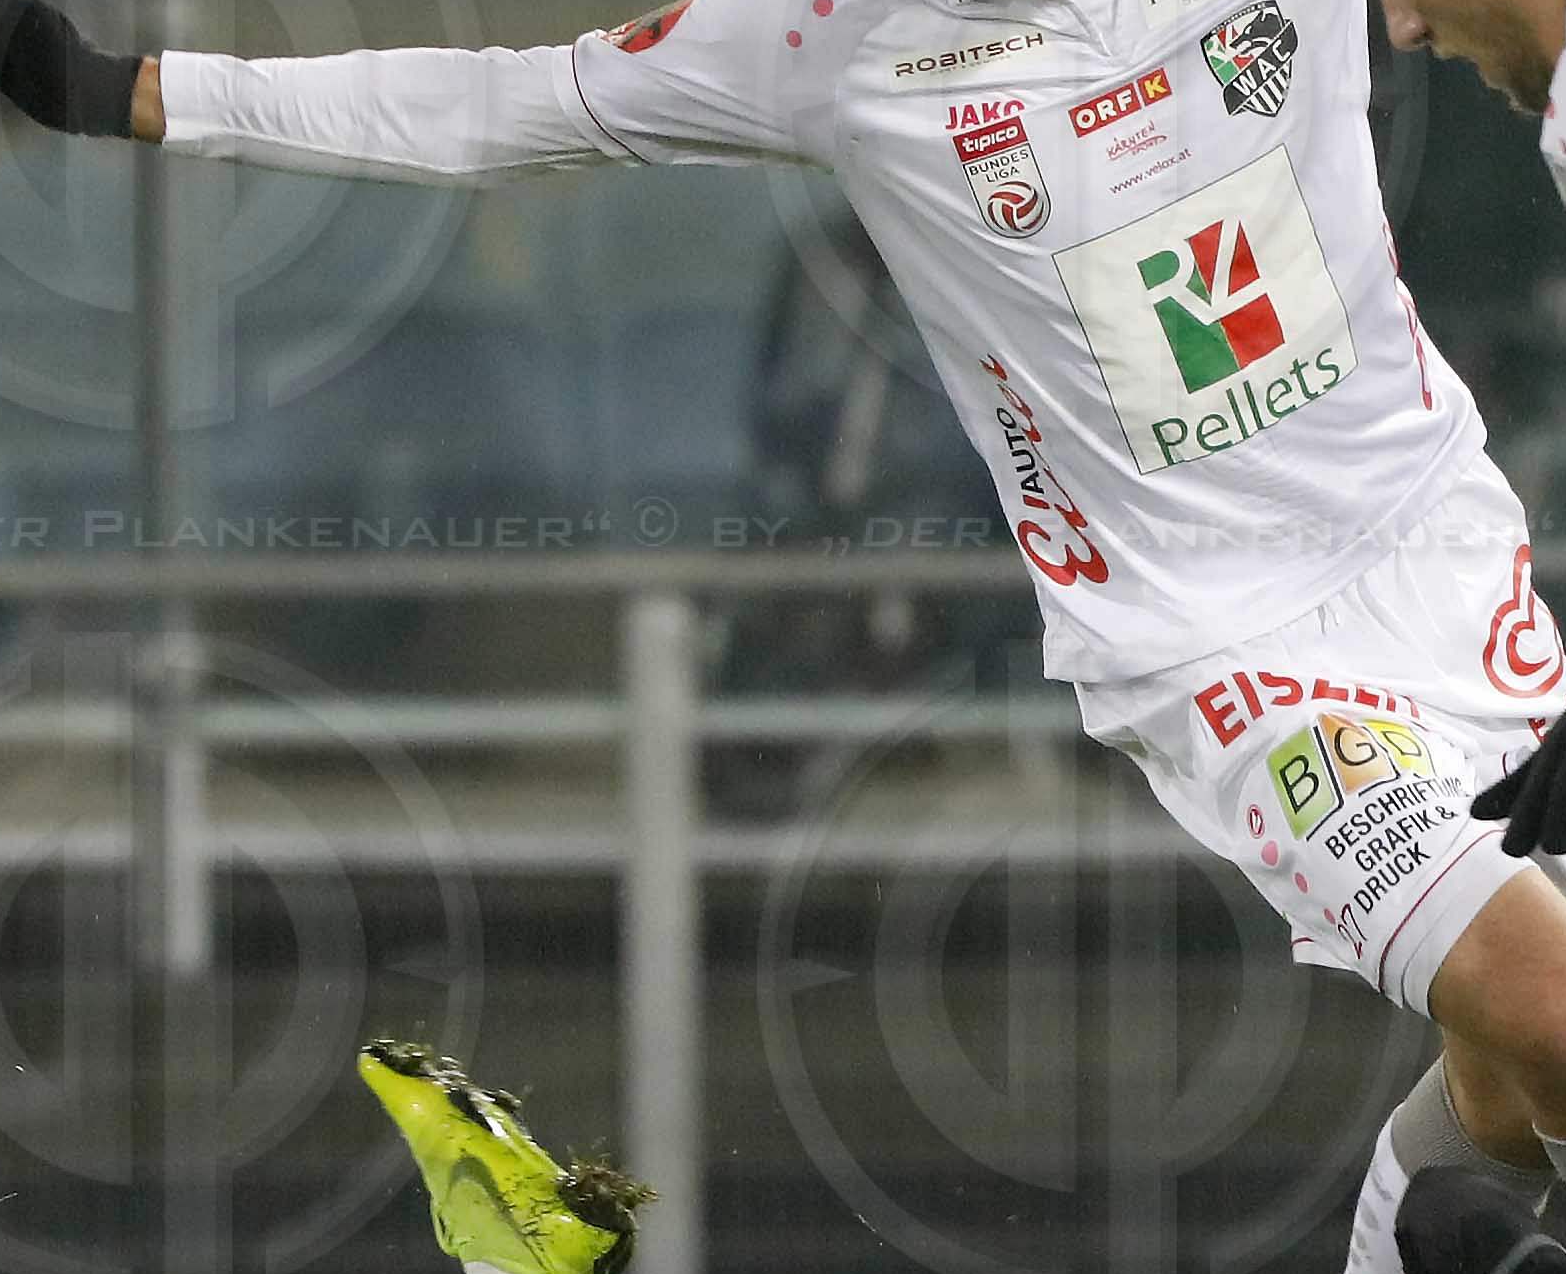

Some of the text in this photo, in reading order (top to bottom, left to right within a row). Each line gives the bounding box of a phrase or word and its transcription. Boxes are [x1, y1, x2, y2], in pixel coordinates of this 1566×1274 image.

[895, 32, 1044, 77] ROBITSCH
[1232, 38, 1292, 97] WAC
[945, 100, 1025, 130] JAKO
[1076, 74, 1169, 128] ORF K
[962, 124, 1020, 153] tipico
[968, 148, 1030, 176] BUNDES
[985, 166, 1021, 183] LIGA
[1152, 345, 1341, 466] Pellets
[996, 408, 1050, 495] AUTO
[1355, 808, 1436, 872] GRAFIK
[1354, 842, 1431, 915] DRUCK
